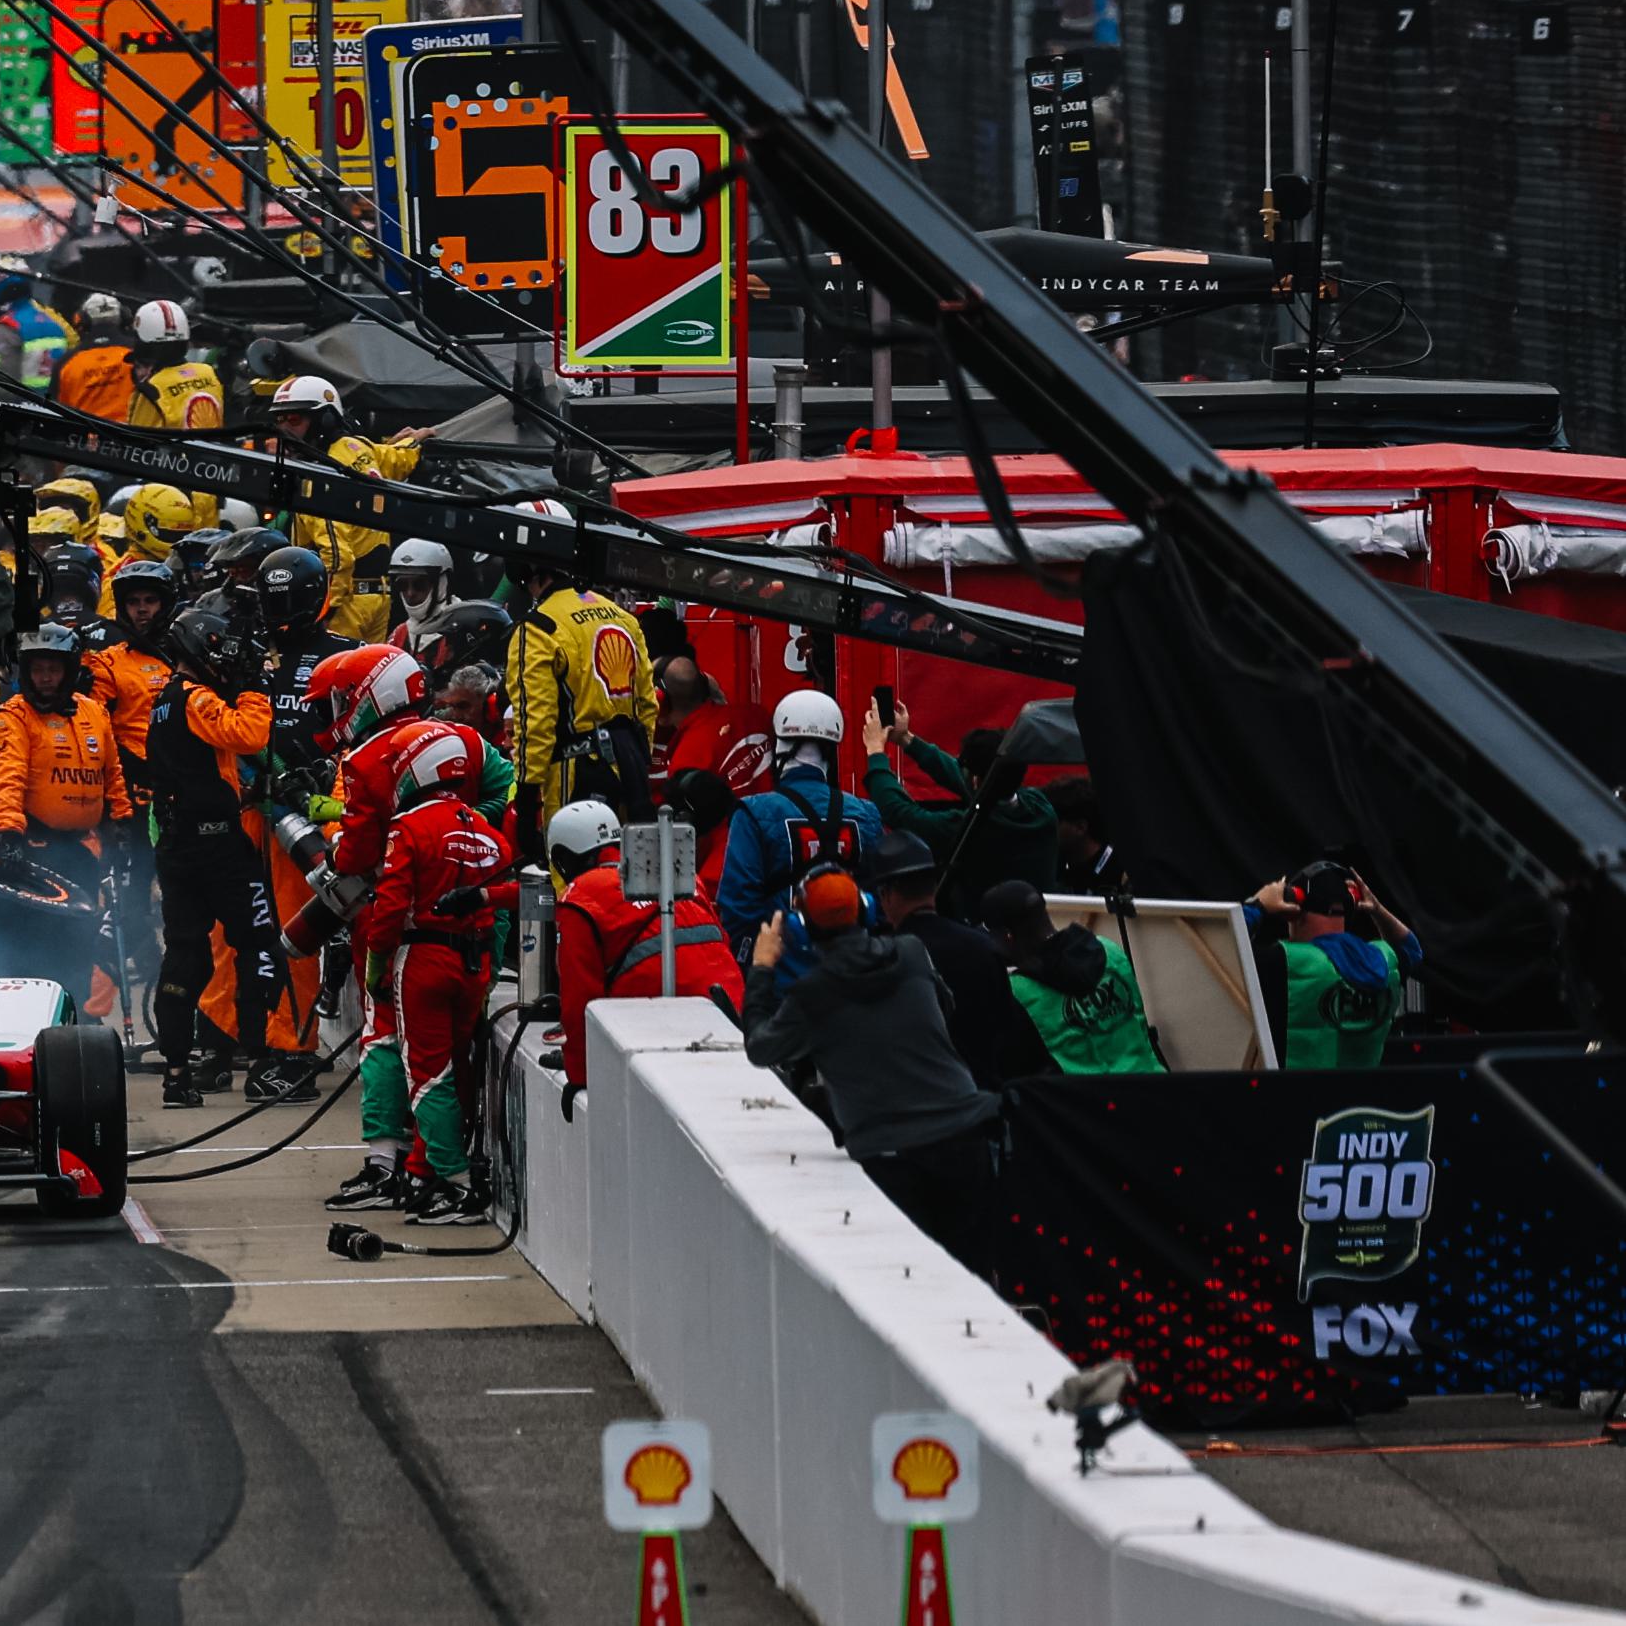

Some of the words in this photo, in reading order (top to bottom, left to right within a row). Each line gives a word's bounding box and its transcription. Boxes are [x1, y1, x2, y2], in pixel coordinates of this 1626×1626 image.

[1397, 8, 1415, 32] 7
[1532, 17, 1551, 41] 6
[411, 32, 490, 51] SiriusXM
[308, 87, 365, 151] 10
[1033, 100, 1088, 116] SirisXM
[431, 95, 569, 291] 5
[587, 148, 703, 254] 83
[1041, 277, 1146, 292] INDYCAR
[1159, 278, 1220, 292] TEAM
[1337, 1131, 1410, 1161] INDY
[1302, 1161, 1431, 1222] 500
[1312, 1302, 1422, 1360] FOX
